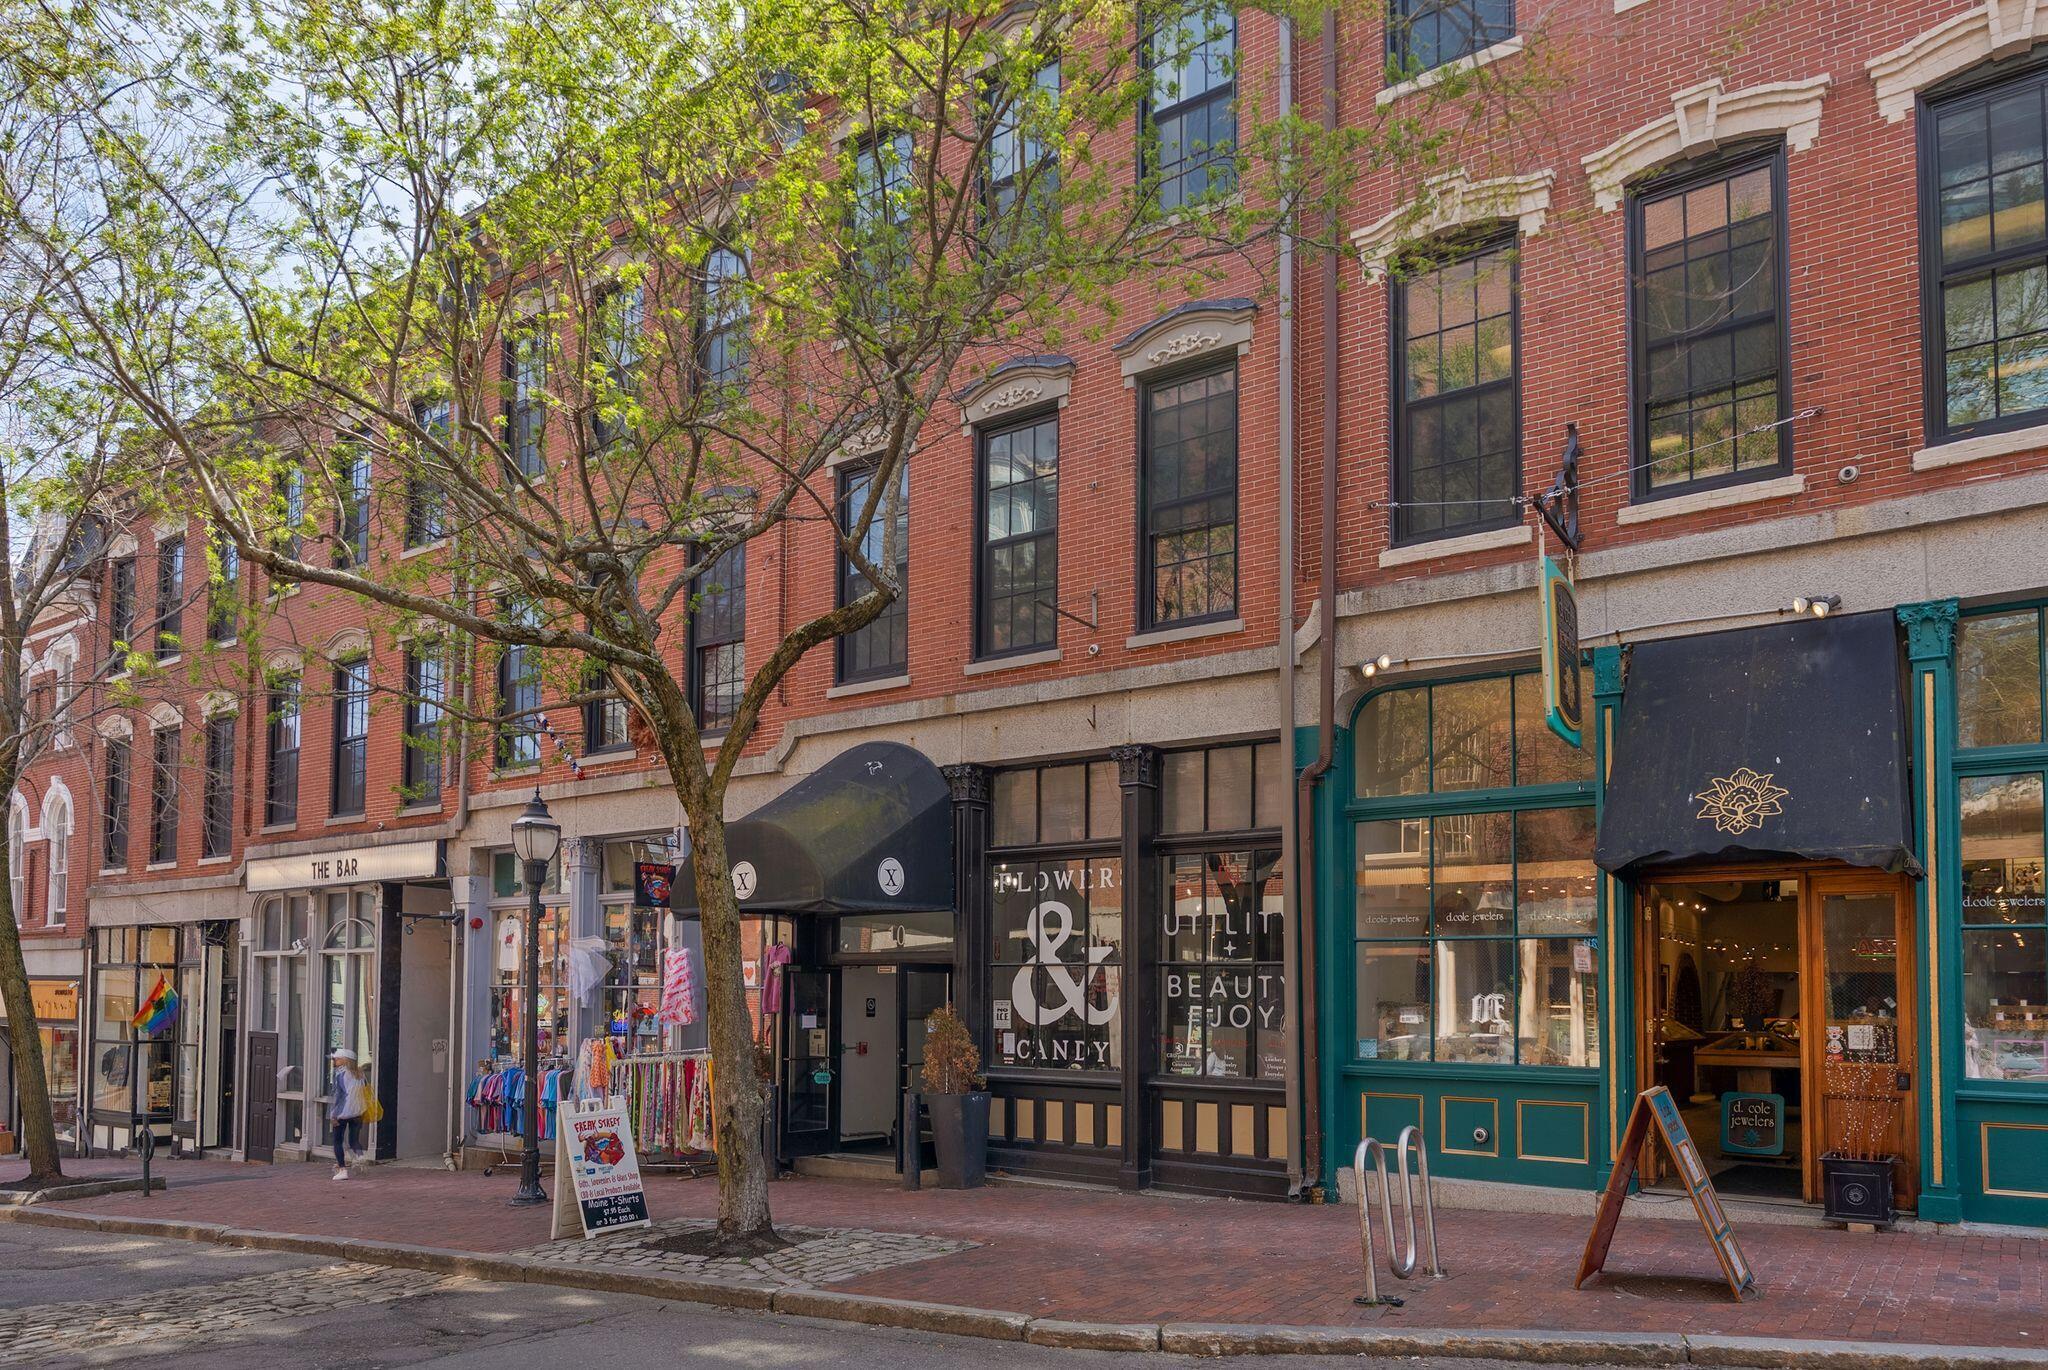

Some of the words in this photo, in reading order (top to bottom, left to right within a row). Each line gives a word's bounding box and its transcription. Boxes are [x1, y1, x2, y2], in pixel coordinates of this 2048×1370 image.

[311, 861, 330, 879] THE
[336, 858, 358, 877] BAR
[736, 872, 750, 890] X
[885, 868, 898, 887] X
[998, 867, 1122, 893] FLOWER
[1962, 895, 1996, 907] d.cole
[1365, 914, 1388, 924] d.cole
[1388, 914, 1420, 925] jewelers
[1446, 912, 1470, 922] d.cole
[1471, 911, 1504, 924] jewelers
[1012, 900, 1120, 1026] &
[996, 1012, 1009, 1021] ICE
[1016, 1039, 1109, 1063] CANDY
[1748, 1101, 1771, 1114] cole
[574, 1119, 598, 1133] FREAK
[598, 1116, 621, 1129] STREET
[1730, 1114, 1775, 1128] jewelers
[588, 1199, 609, 1209] Maine
[609, 1194, 640, 1206] T-Shirts
[603, 1207, 617, 1216] $7.95
[617, 1206, 631, 1214] Each
[609, 1216, 618, 1225] for
